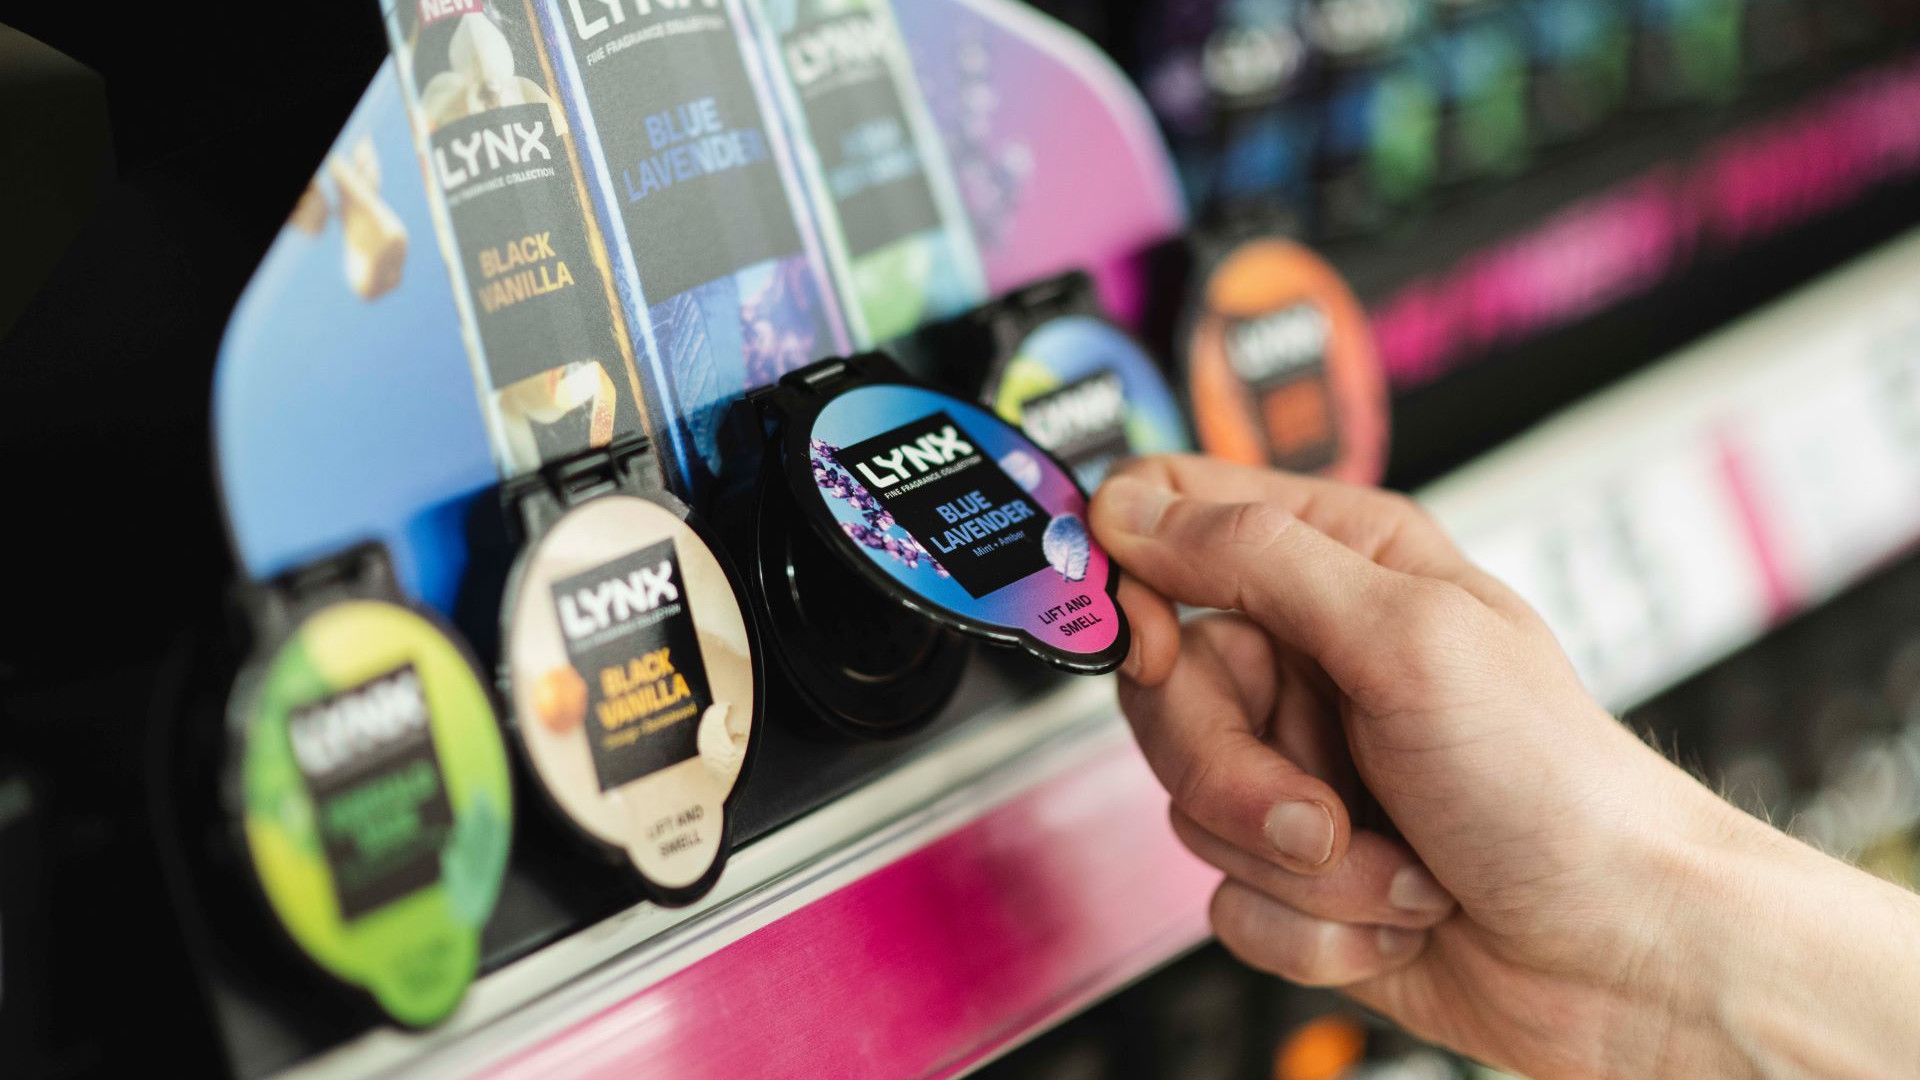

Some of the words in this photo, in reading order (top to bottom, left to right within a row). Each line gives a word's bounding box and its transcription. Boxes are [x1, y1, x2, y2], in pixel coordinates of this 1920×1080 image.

[644, 97, 723, 150] BLUE
[434, 121, 552, 189] LYNX
[505, 167, 555, 185] COLLECTION
[479, 231, 556, 278] BLACK
[478, 261, 575, 314] VANILLA
[856, 425, 974, 488] LYNX
[884, 488, 903, 500] FINE
[901, 472, 942, 493] FRAGRANCE
[936, 490, 993, 524] BLUE
[930, 499, 1035, 554] LAVENDER
[972, 543, 995, 557] Mint
[998, 530, 1025, 547] Amber
[559, 559, 679, 638] LYNX
[1038, 605, 1066, 625] LIFT
[1064, 594, 1092, 614] AND
[1059, 612, 1102, 637] SMELL
[600, 647, 675, 699] BLACK
[596, 673, 692, 731] VANILLA
[676, 804, 704, 828] AND
